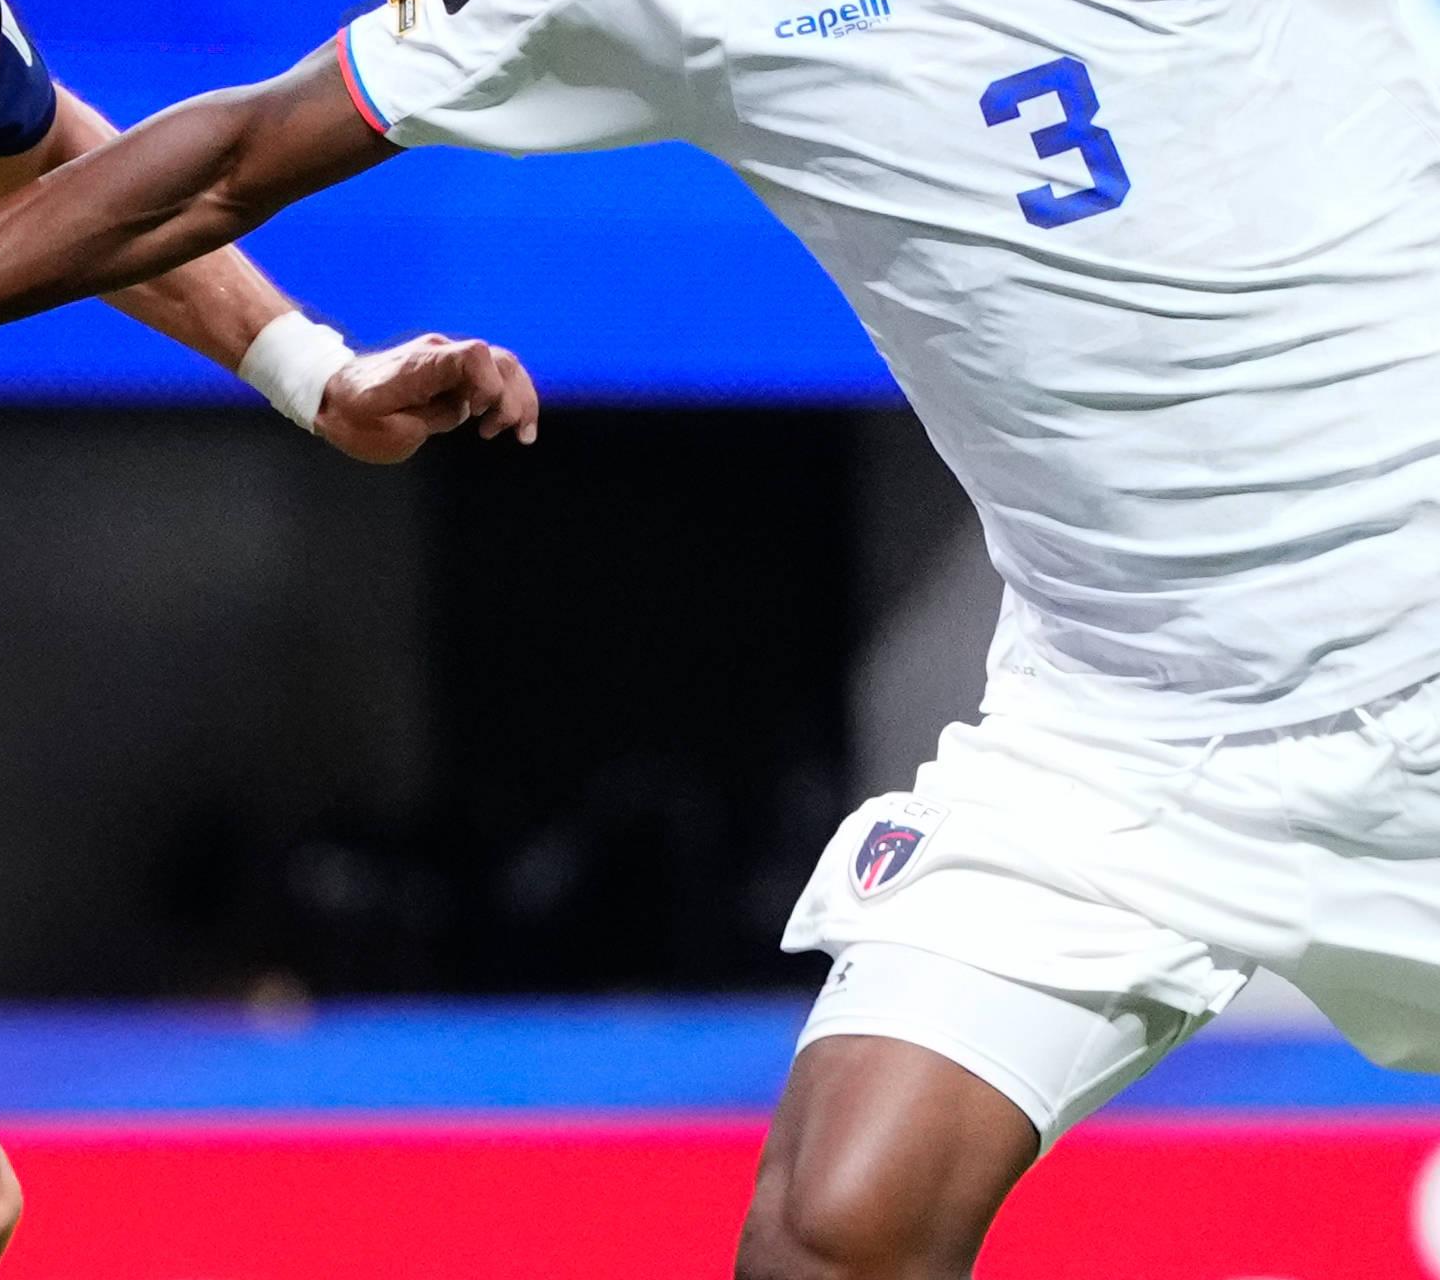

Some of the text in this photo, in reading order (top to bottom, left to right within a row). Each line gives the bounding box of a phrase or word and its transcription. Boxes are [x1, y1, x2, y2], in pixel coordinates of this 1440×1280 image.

[832, 17, 890, 39] SPO
[978, 56, 1132, 230] 3
[889, 801, 941, 819] CF
